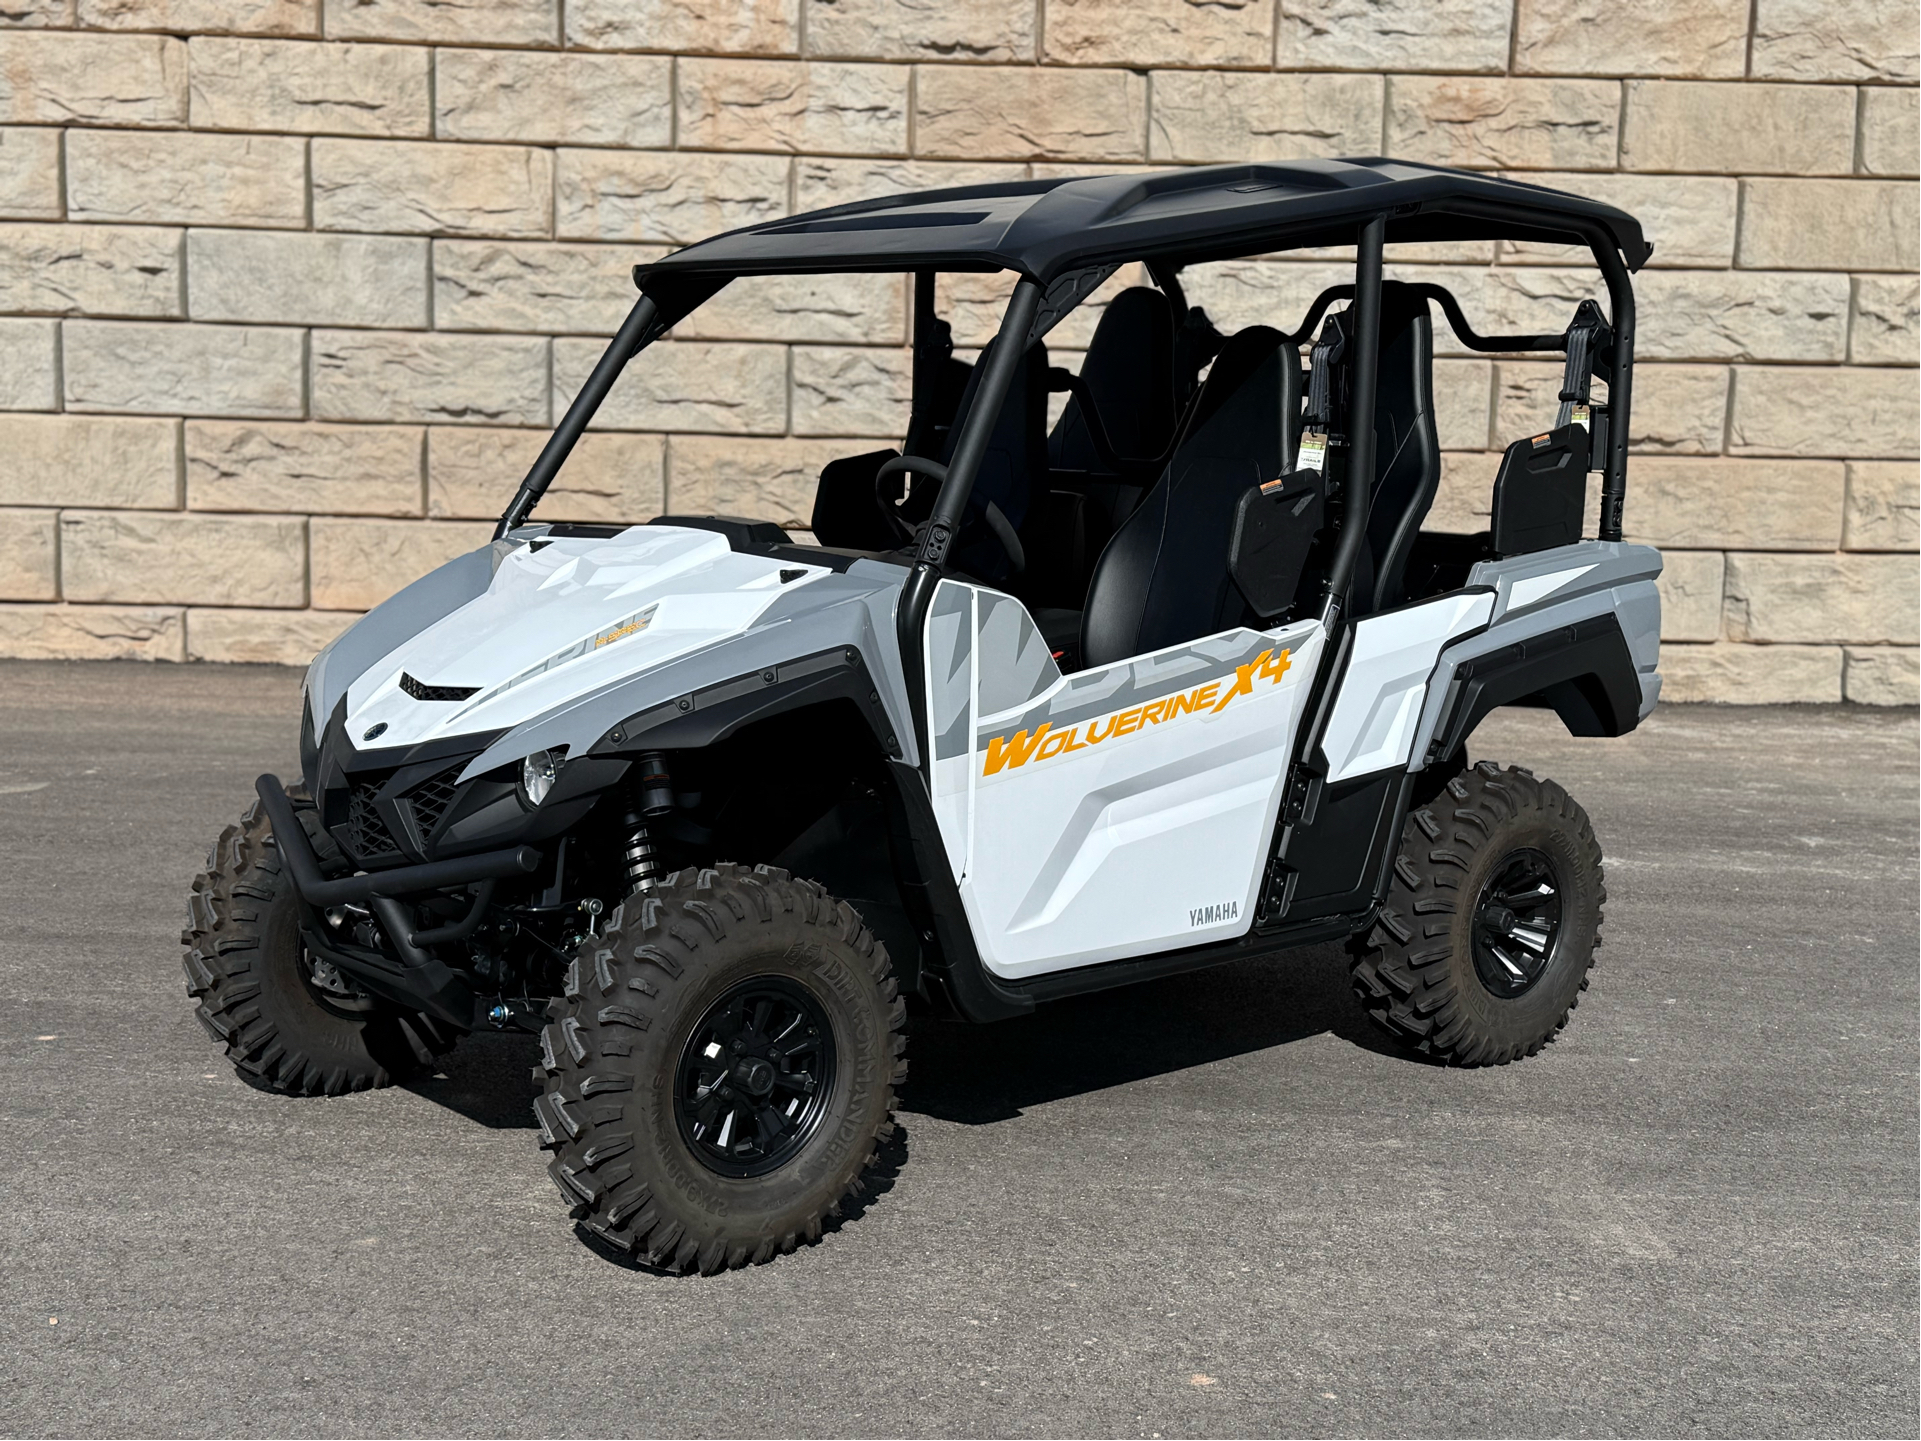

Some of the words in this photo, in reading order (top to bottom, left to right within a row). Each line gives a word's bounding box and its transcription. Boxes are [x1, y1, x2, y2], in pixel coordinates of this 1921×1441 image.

[982, 681, 1221, 776] WOLVERINE
[1210, 648, 1292, 714] X4
[1189, 901, 1238, 927] YAMAHA
[822, 959, 864, 1003] DIRT
[820, 1005, 876, 1173] COMMANDER
